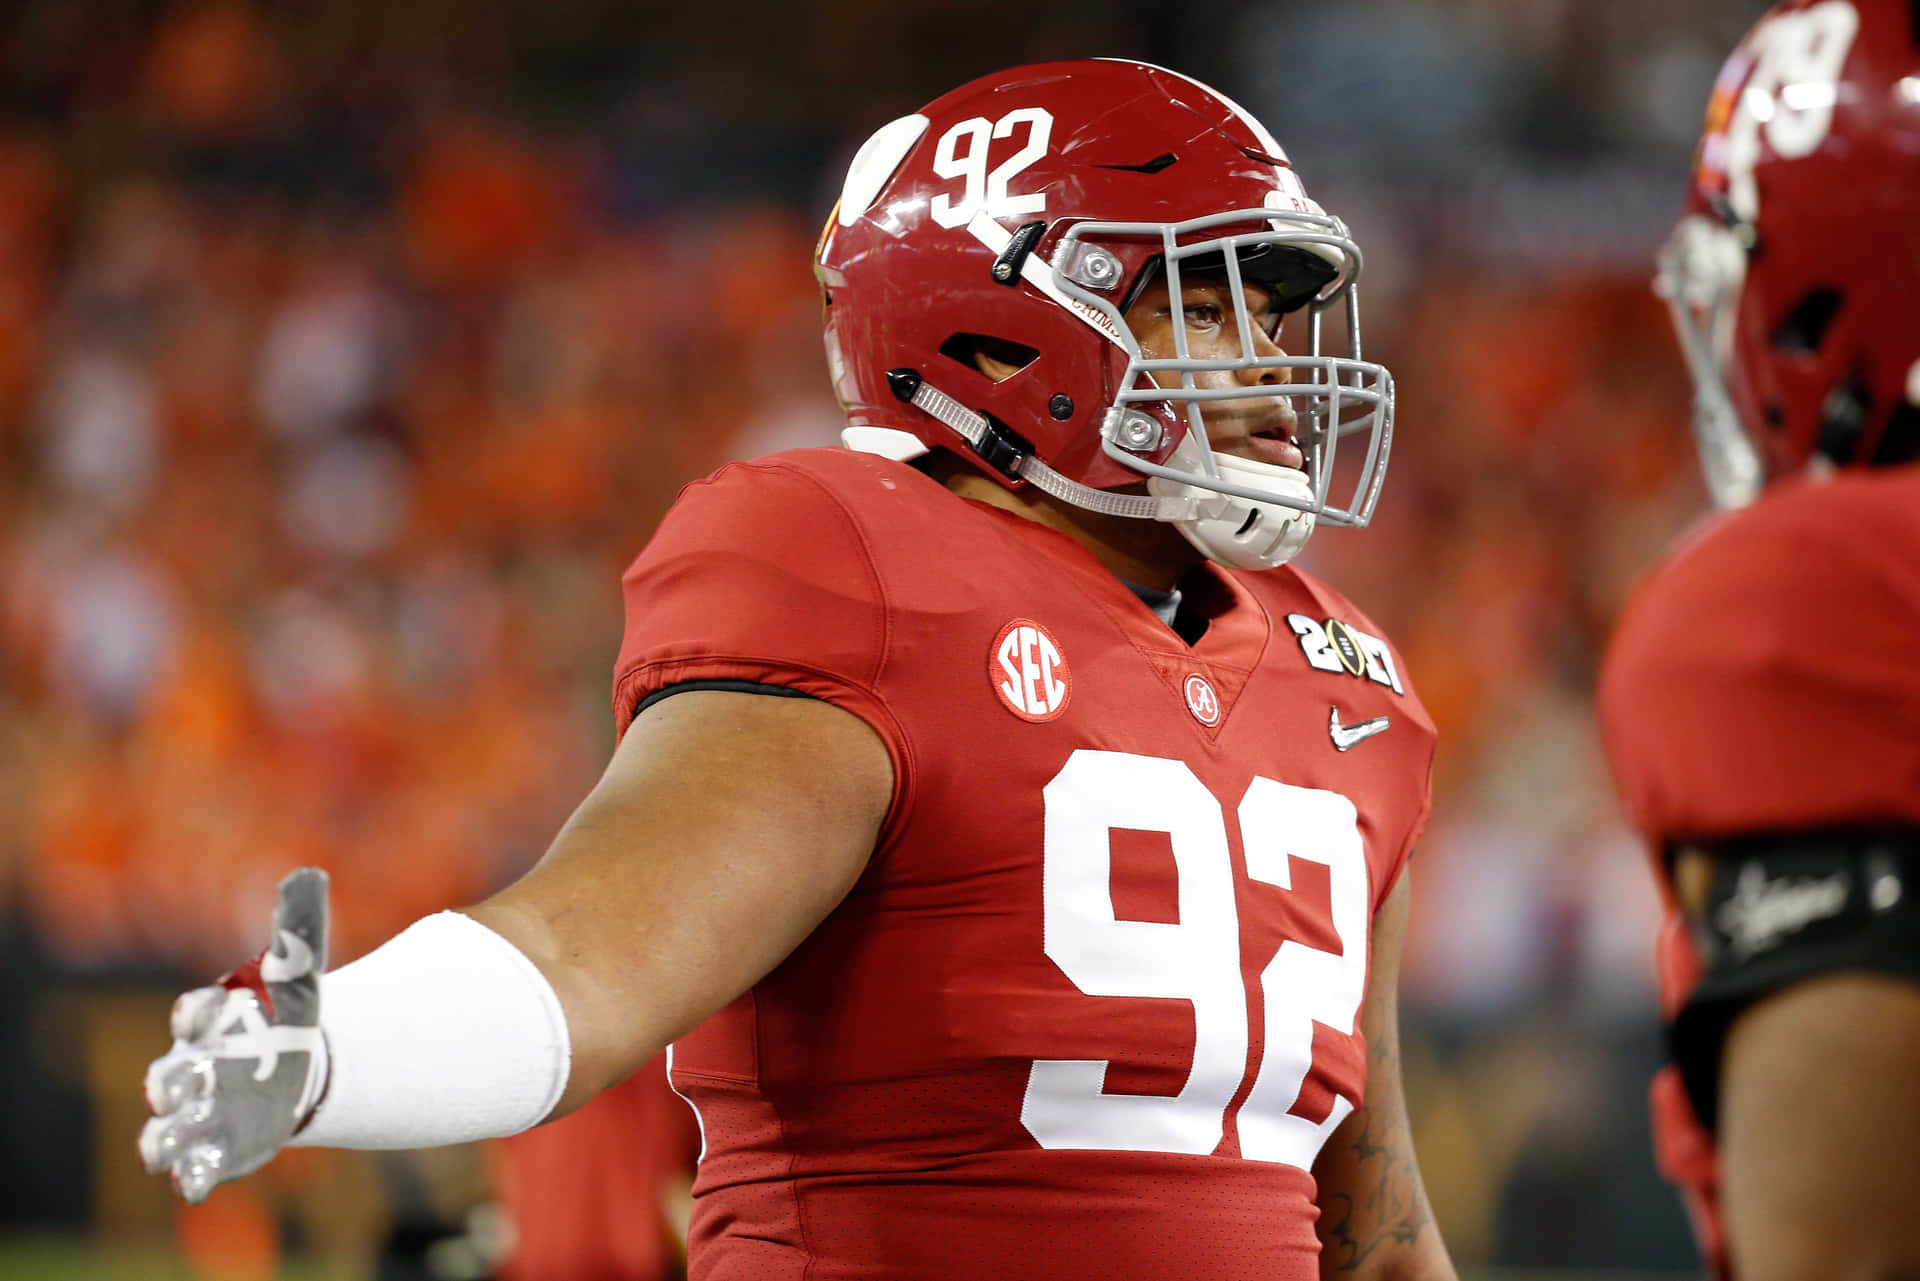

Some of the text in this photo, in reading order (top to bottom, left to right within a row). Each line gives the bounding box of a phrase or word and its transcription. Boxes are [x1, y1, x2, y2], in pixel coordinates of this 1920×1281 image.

[931, 107, 1054, 229] 92
[997, 626, 1066, 715] SEC
[1020, 749, 1368, 1172] 92
